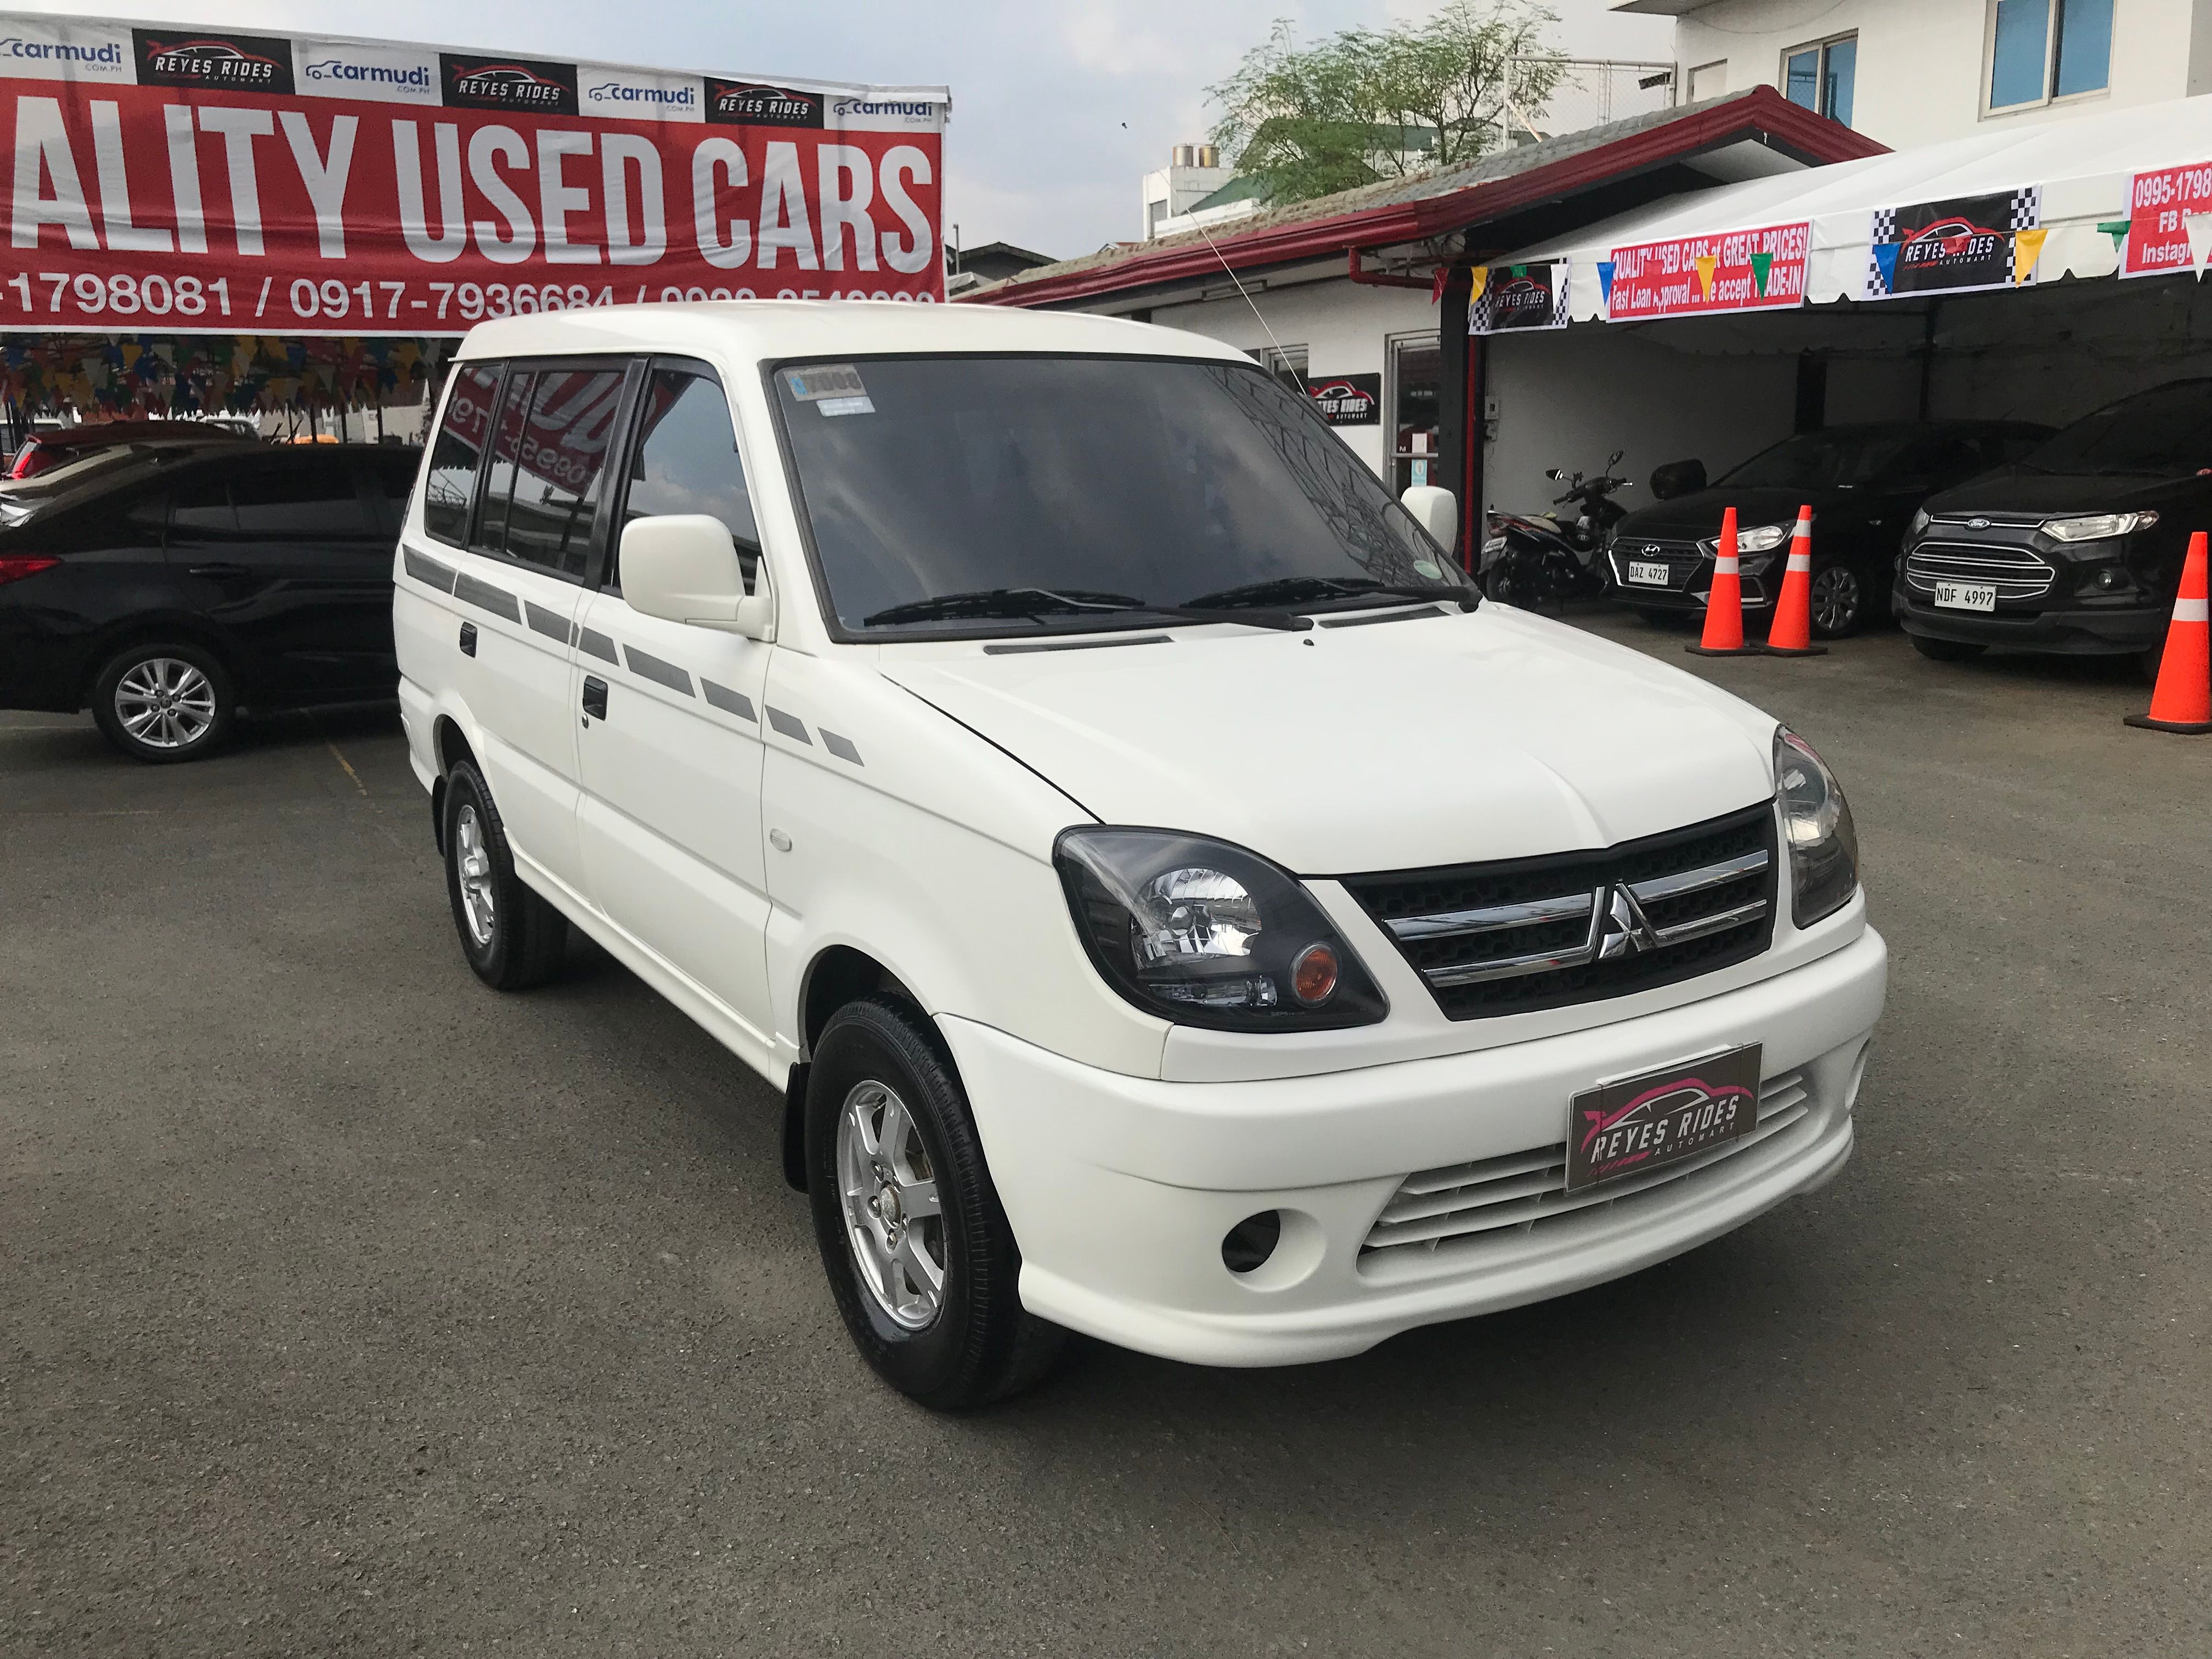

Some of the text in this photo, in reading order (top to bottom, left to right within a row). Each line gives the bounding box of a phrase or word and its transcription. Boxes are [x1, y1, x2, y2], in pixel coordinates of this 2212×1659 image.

[12, 43, 121, 64] carmudi
[155, 57, 273, 78] REYES RIDES
[332, 64, 430, 86] carmudi
[459, 80, 561, 100] REYES RIDES
[611, 87, 694, 104] carmudi
[719, 98, 809, 115] REYES RIDES
[853, 102, 932, 116] carmudi
[12, 95, 933, 274] ALITY USED CARS
[2135, 167, 2212, 208] 0995-1798
[2159, 210, 2178, 233] FB
[1723, 233, 1760, 268] GREAT
[1763, 227, 1807, 262] PRICES!
[1905, 236, 1995, 263] REYES DES
[1939, 255, 1991, 266] AUTOMART
[1612, 285, 1629, 311] Fast
[1630, 283, 1651, 309] Loan
[1718, 271, 1751, 306] accept
[1630, 566, 1667, 580] DAZ 4727
[1937, 588, 1994, 606] NDF 4997
[1590, 1095, 1739, 1164] REYES RIDES
[1655, 1121, 1734, 1156] AUTOMART
